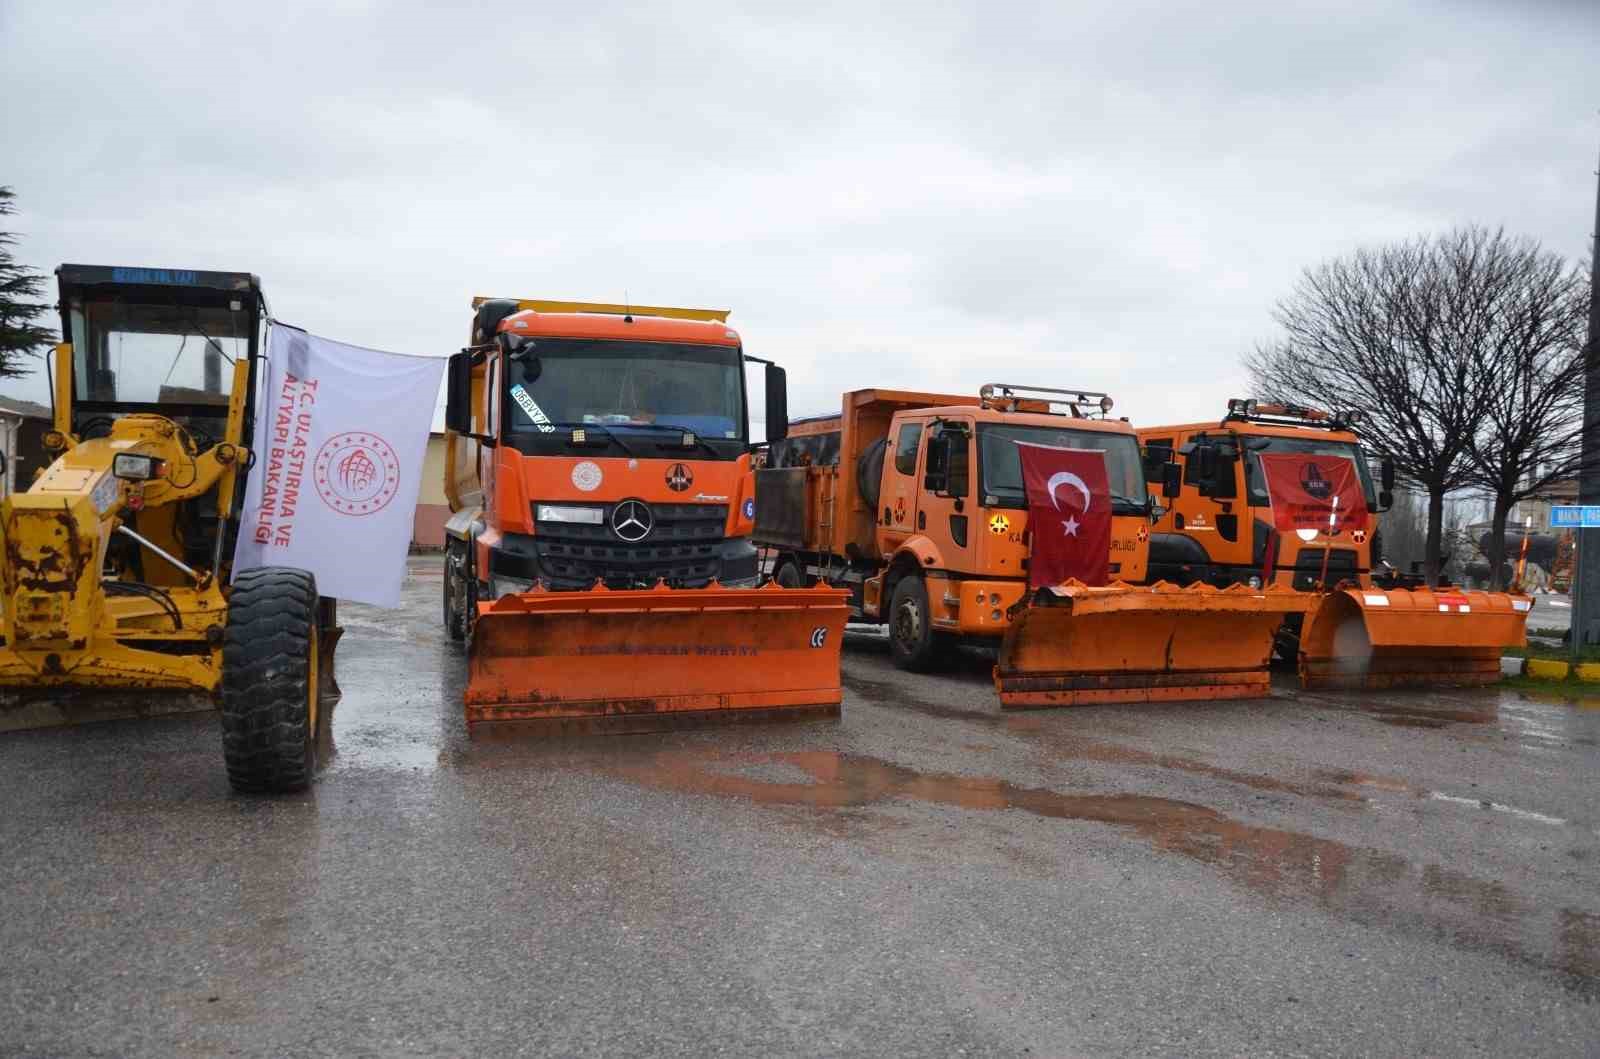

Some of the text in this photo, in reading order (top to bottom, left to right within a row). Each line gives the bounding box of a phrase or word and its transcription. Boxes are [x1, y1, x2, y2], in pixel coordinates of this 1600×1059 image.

[255, 371, 299, 545] ALTYAPI BAKANLIĞI
[274, 379, 318, 548] T.C. ULAŞTIRMA VE
